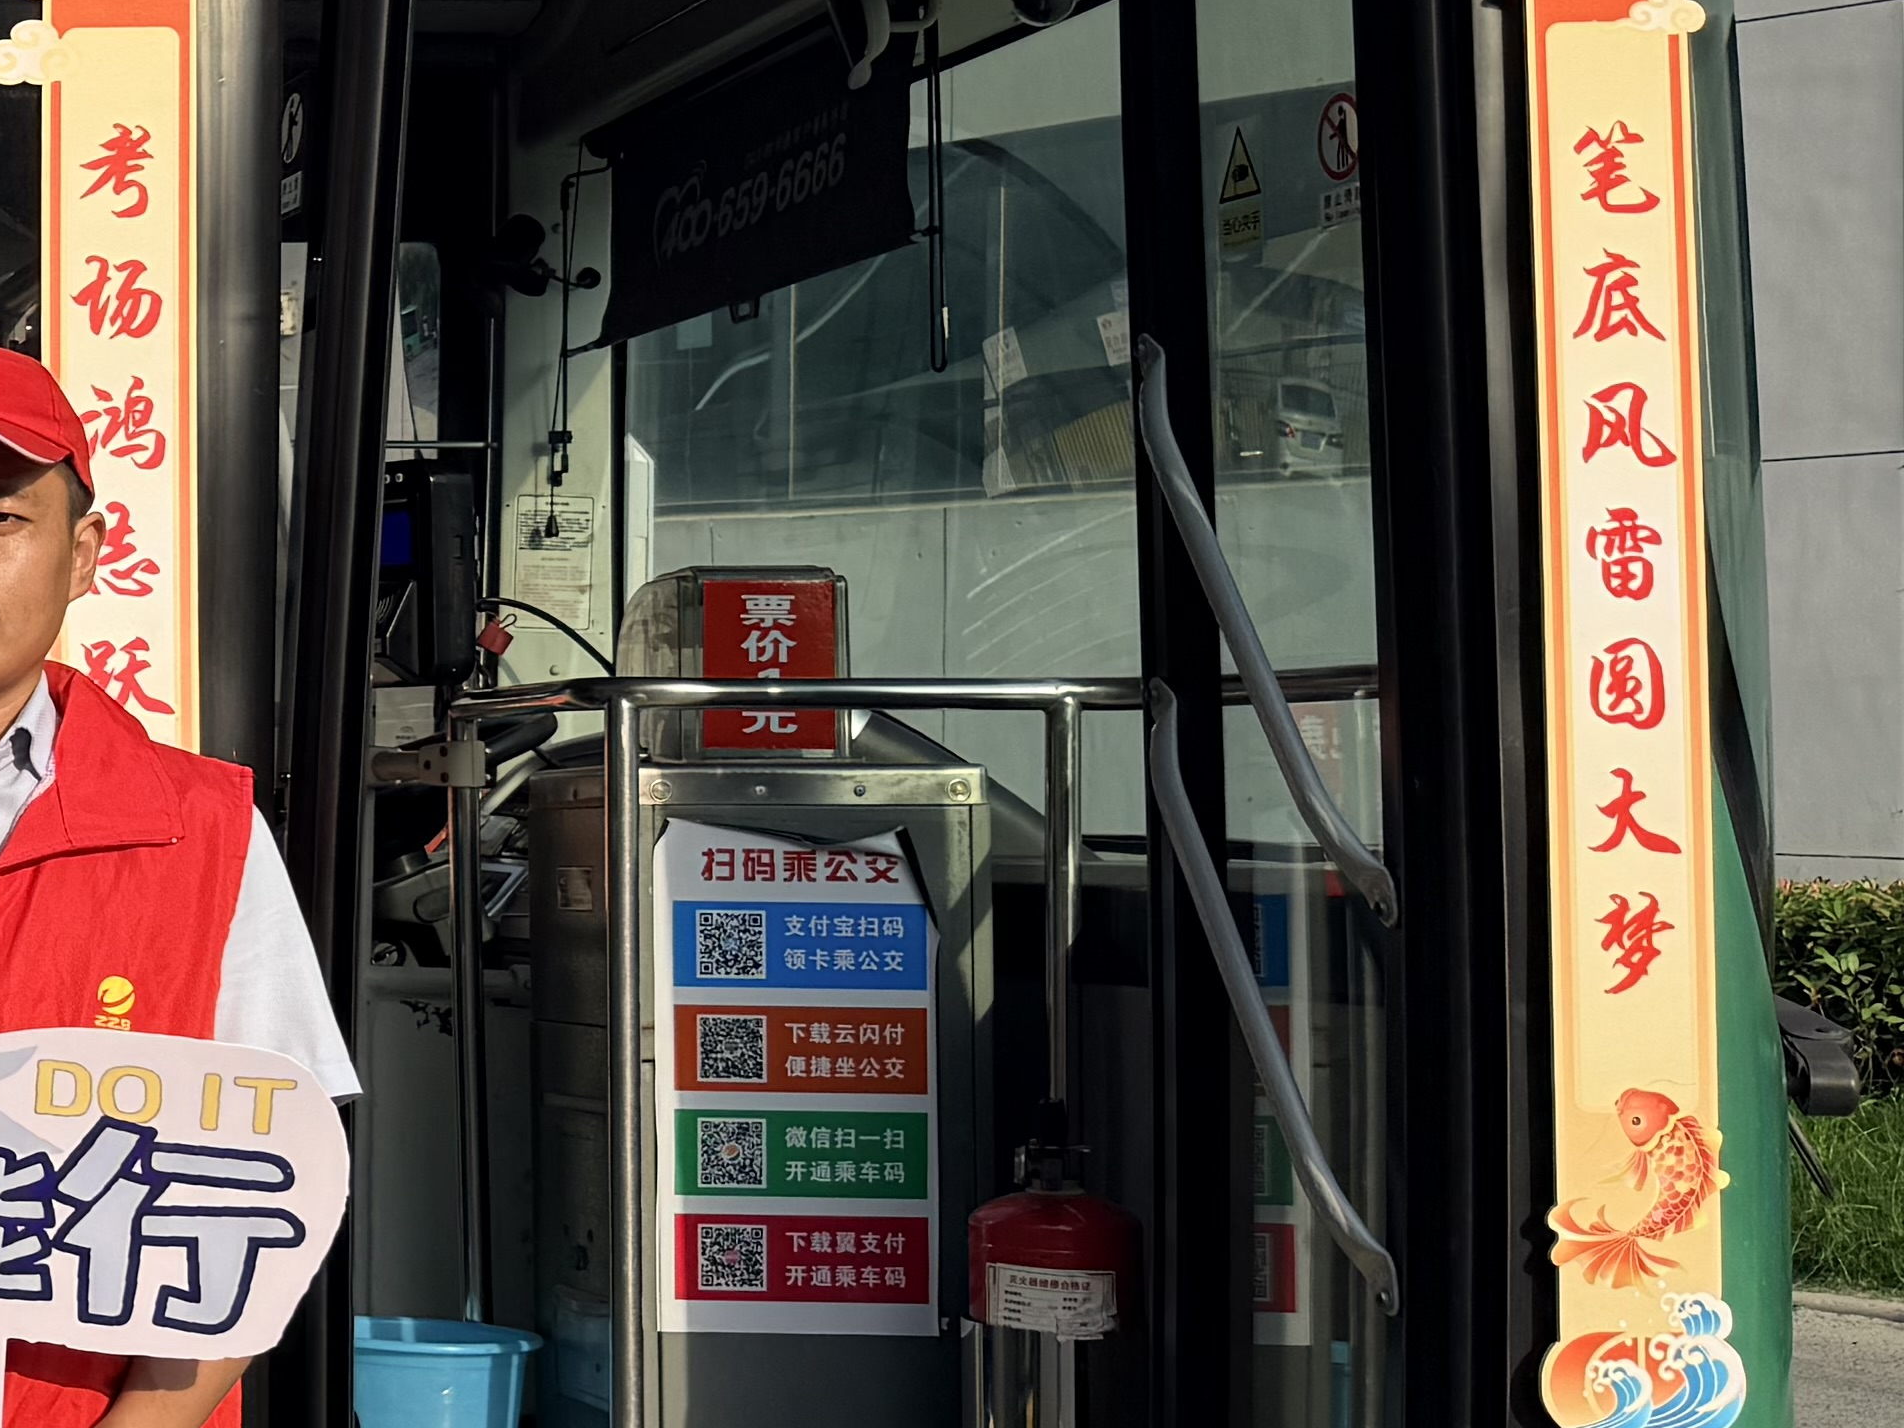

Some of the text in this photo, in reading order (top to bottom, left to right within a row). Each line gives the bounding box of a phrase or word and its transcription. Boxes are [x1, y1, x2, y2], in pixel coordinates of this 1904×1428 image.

[1572, 118, 1681, 995] 笔底风雷圆大梦
[739, 594, 798, 735] 票价元
[701, 847, 900, 884] 扫码乘公交
[783, 915, 905, 938] 支付宝扫码
[783, 948, 905, 972] 领卡乘公交
[784, 1022, 905, 1046] 下载云闪付
[34, 1059, 298, 1135] DO IT
[784, 1126, 905, 1150] 微信扫一扫
[784, 1160, 905, 1184] 开通乘车码
[784, 1231, 905, 1255] 下载翼支付
[784, 1265, 905, 1289] 开通乘车码
